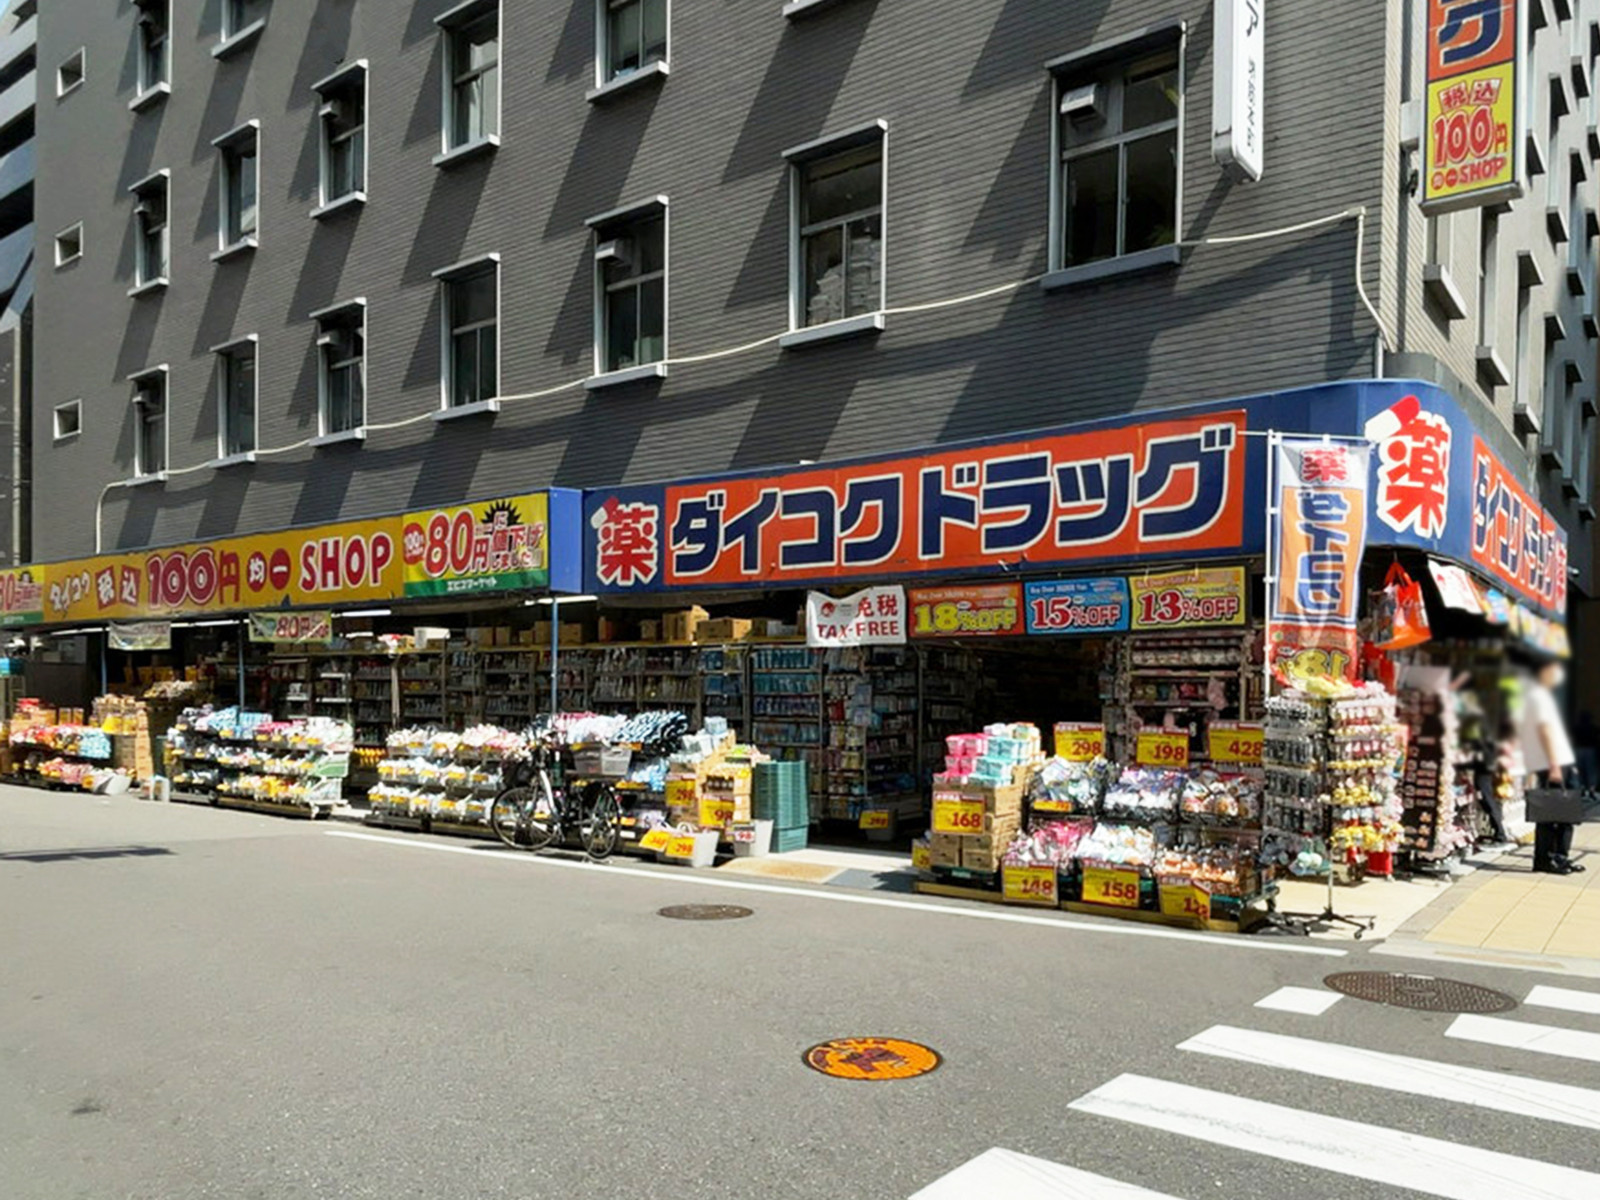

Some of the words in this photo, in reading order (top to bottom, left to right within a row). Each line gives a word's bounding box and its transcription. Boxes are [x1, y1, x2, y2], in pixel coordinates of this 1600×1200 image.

[1432, 104, 1508, 168] 100円
[1458, 157, 1507, 186] SHOP
[1365, 395, 1452, 540] 薬
[597, 497, 659, 586] 薬
[146, 548, 240, 609] 100円
[299, 532, 393, 593] SHOP
[856, 594, 898, 618] 免税
[914, 602, 1018, 634] 18%OFF
[1031, 597, 1121, 629] 15%OFF
[1138, 589, 1239, 625] 13%OFF
[1072, 741, 1101, 756] 298
[1153, 743, 1185, 761] 198
[1228, 741, 1263, 757] 428
[951, 812, 981, 828] 168
[1101, 881, 1137, 900] 158
